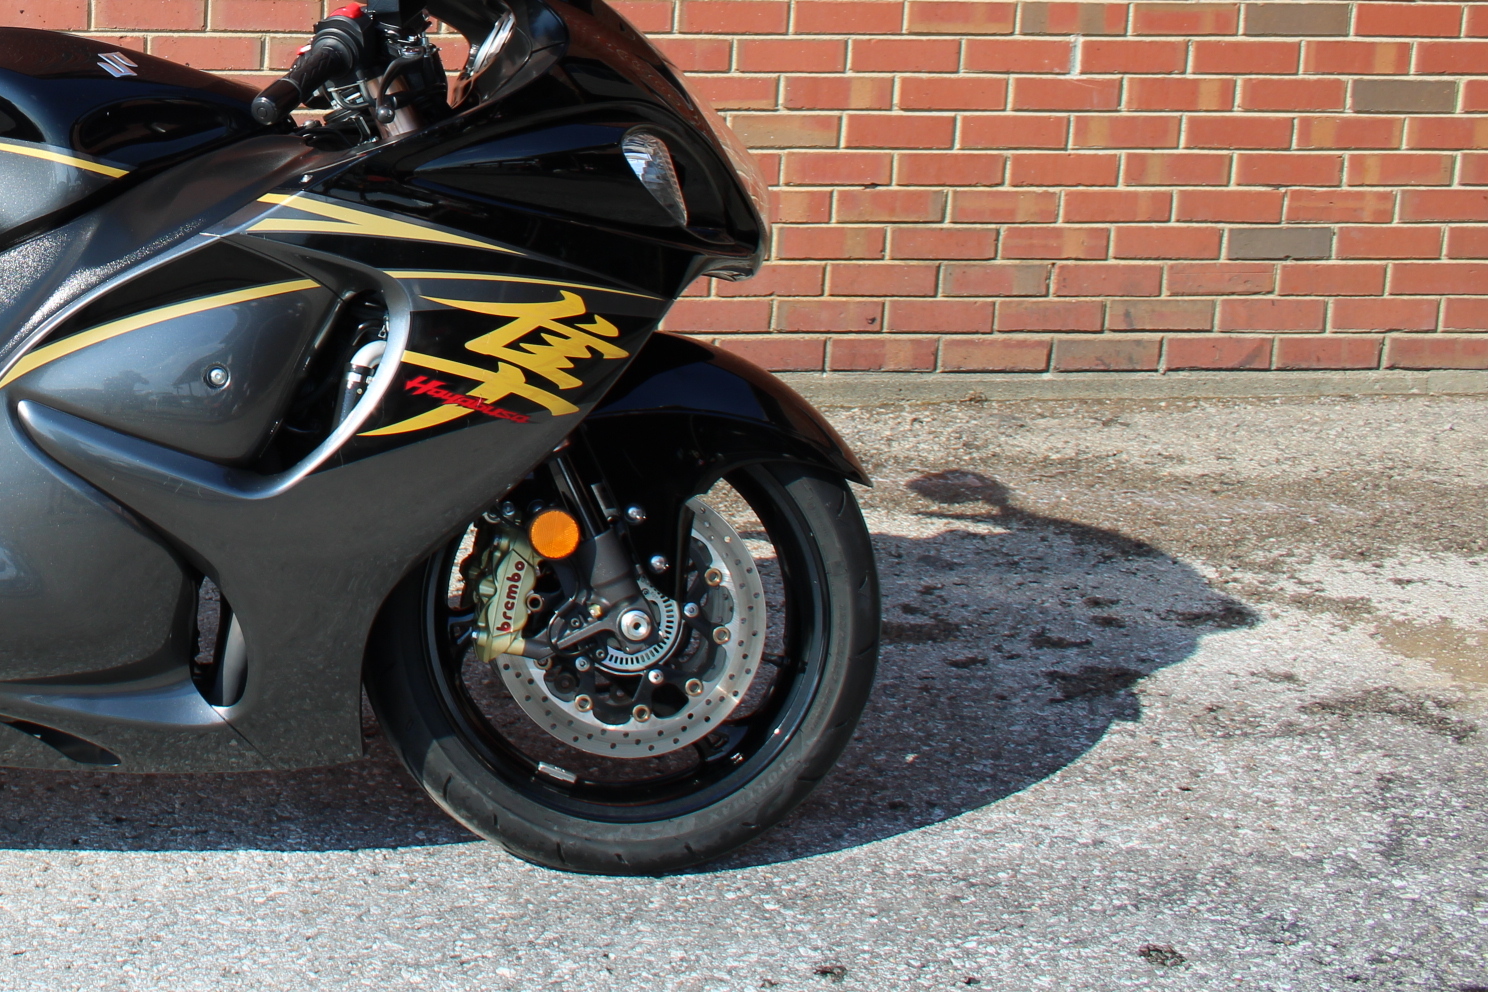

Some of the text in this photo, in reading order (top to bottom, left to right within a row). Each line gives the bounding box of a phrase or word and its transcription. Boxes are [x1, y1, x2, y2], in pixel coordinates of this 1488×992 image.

[404, 375, 536, 424] Hayabusa
[495, 560, 526, 633] brembo
[708, 753, 796, 822] SPORTMAX
